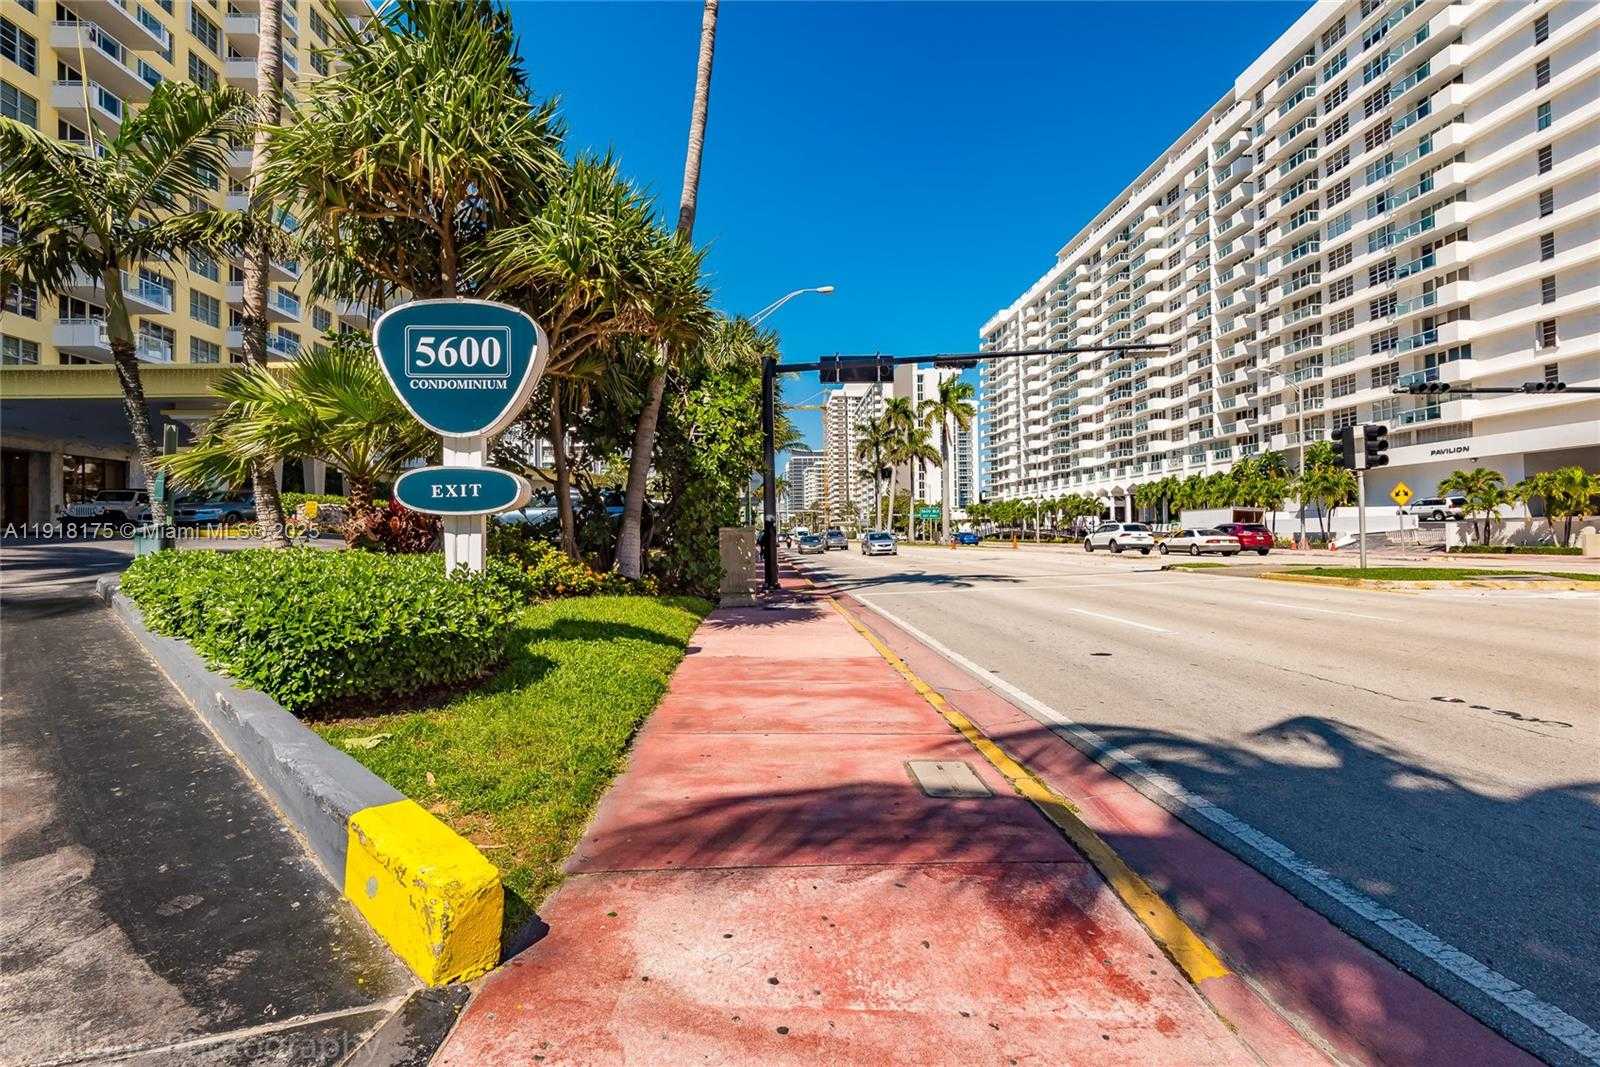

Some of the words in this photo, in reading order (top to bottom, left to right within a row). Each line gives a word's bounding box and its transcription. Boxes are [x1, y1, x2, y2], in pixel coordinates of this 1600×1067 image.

[415, 336, 501, 367] 5600
[409, 379, 508, 390] CONDOMINIUM
[1430, 445, 1470, 456] PAVILION
[431, 483, 482, 498] EXIT
